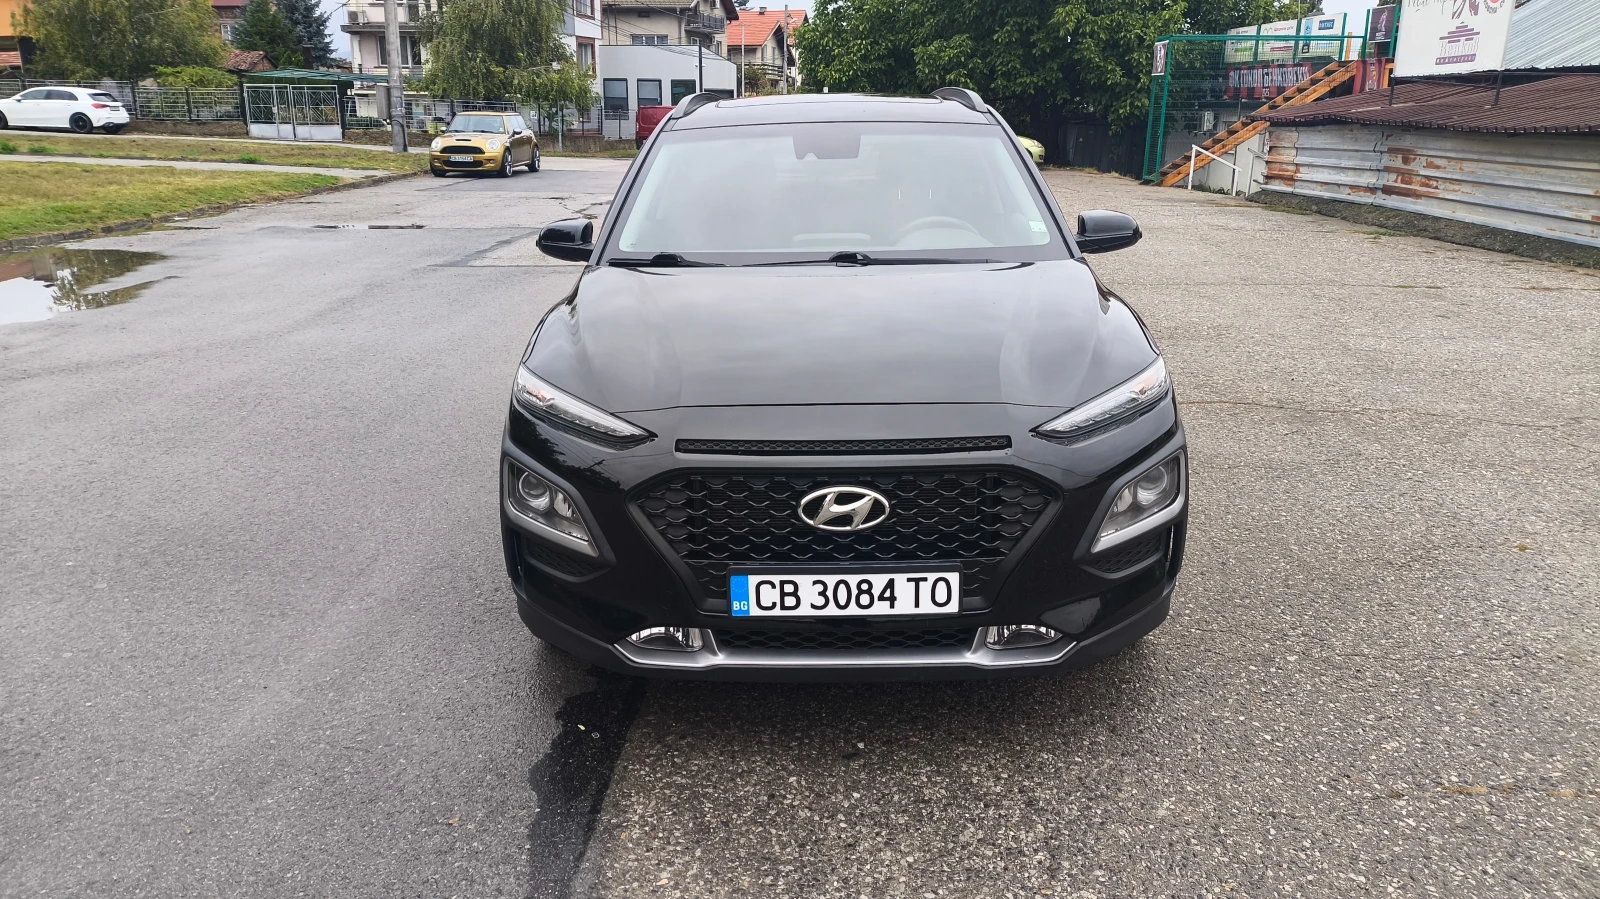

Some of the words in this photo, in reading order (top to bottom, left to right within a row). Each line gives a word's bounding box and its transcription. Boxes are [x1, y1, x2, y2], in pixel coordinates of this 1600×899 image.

[755, 579, 801, 611] CB
[810, 578, 897, 611] 3084
[906, 576, 953, 609] TO
[733, 601, 748, 611] BG
